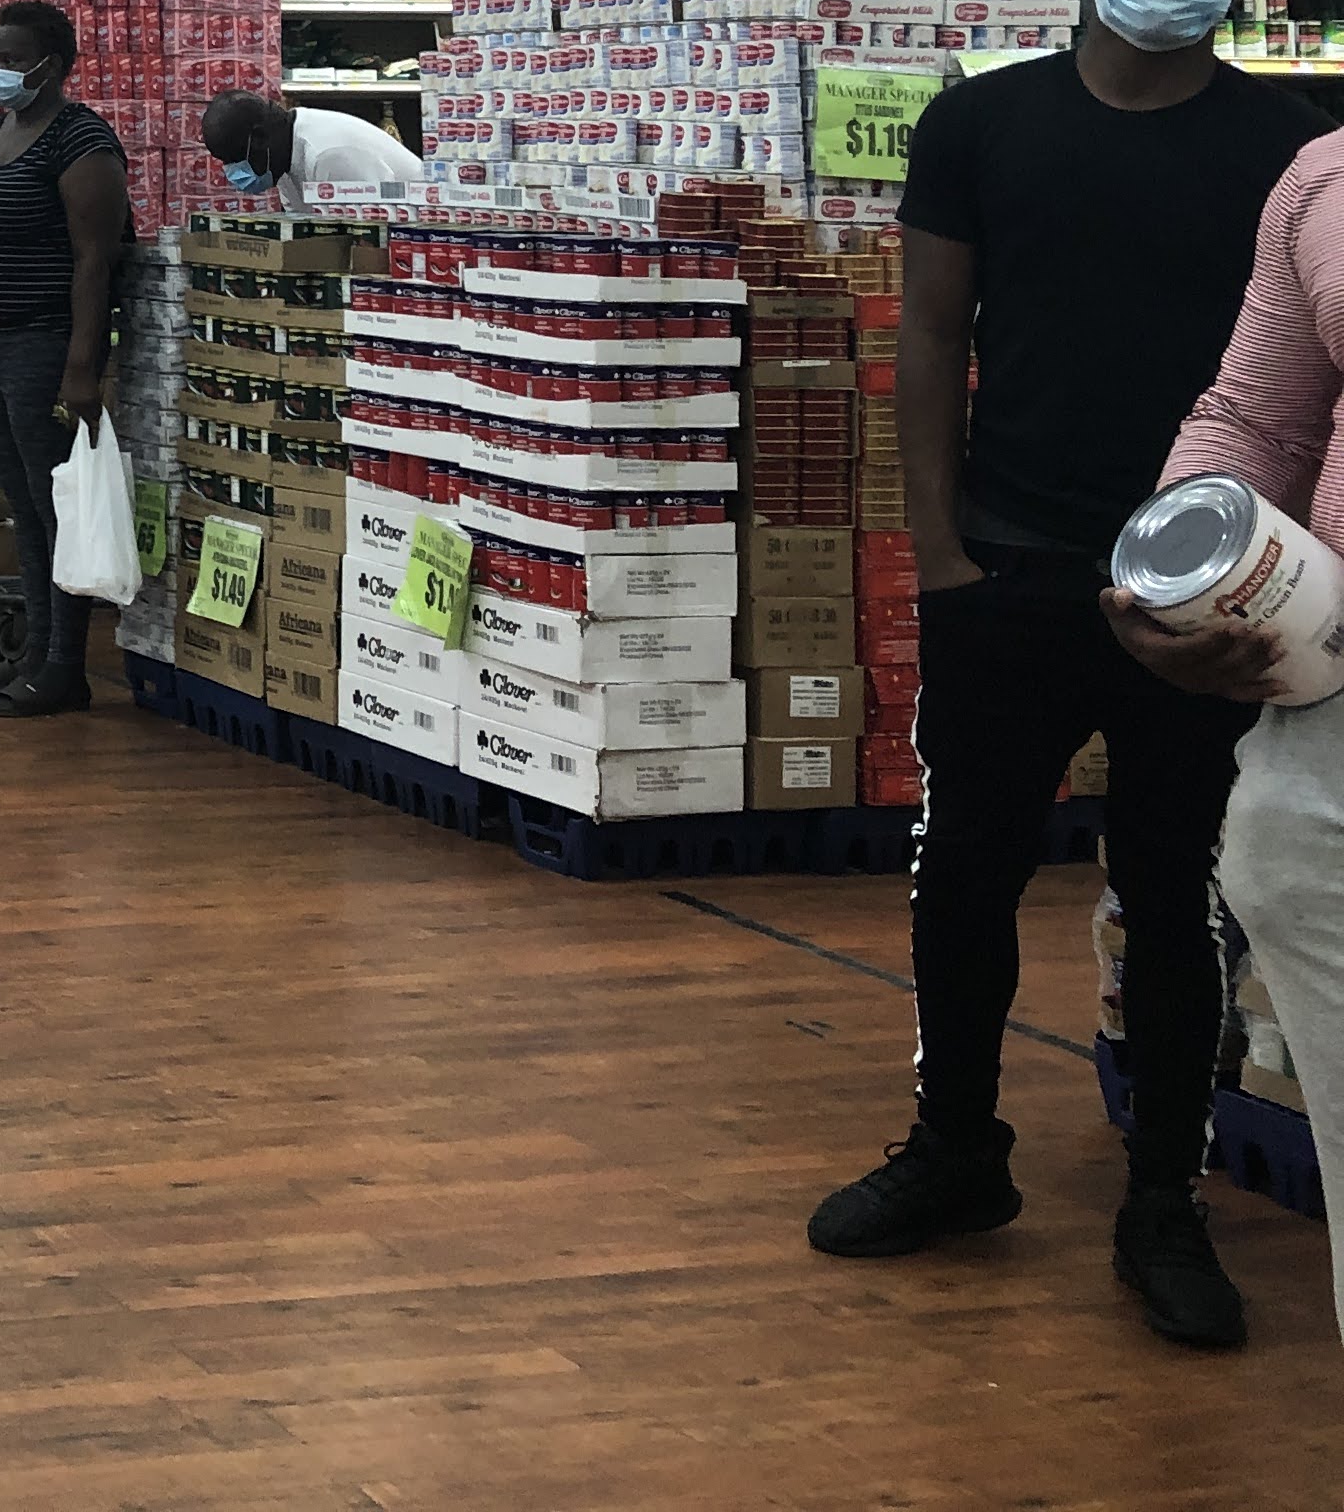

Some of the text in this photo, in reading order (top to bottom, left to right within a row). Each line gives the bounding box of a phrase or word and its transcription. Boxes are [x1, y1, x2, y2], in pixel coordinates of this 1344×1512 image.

[826, 84, 938, 103] MANAGER SPECIA
[846, 117, 913, 159] $1.19
[372, 517, 408, 542] Clover
[281, 557, 326, 580] Africana
[1236, 543, 1280, 605] HANOVER
[212, 568, 246, 607] $1.49
[1254, 559, 1306, 627] ut Green Beans
[279, 612, 322, 633] Africana
[483, 608, 522, 636] Clover
[368, 637, 405, 665] Clover
[493, 673, 536, 702] Clover
[364, 694, 399, 723] Clover
[490, 735, 533, 764] Clover
